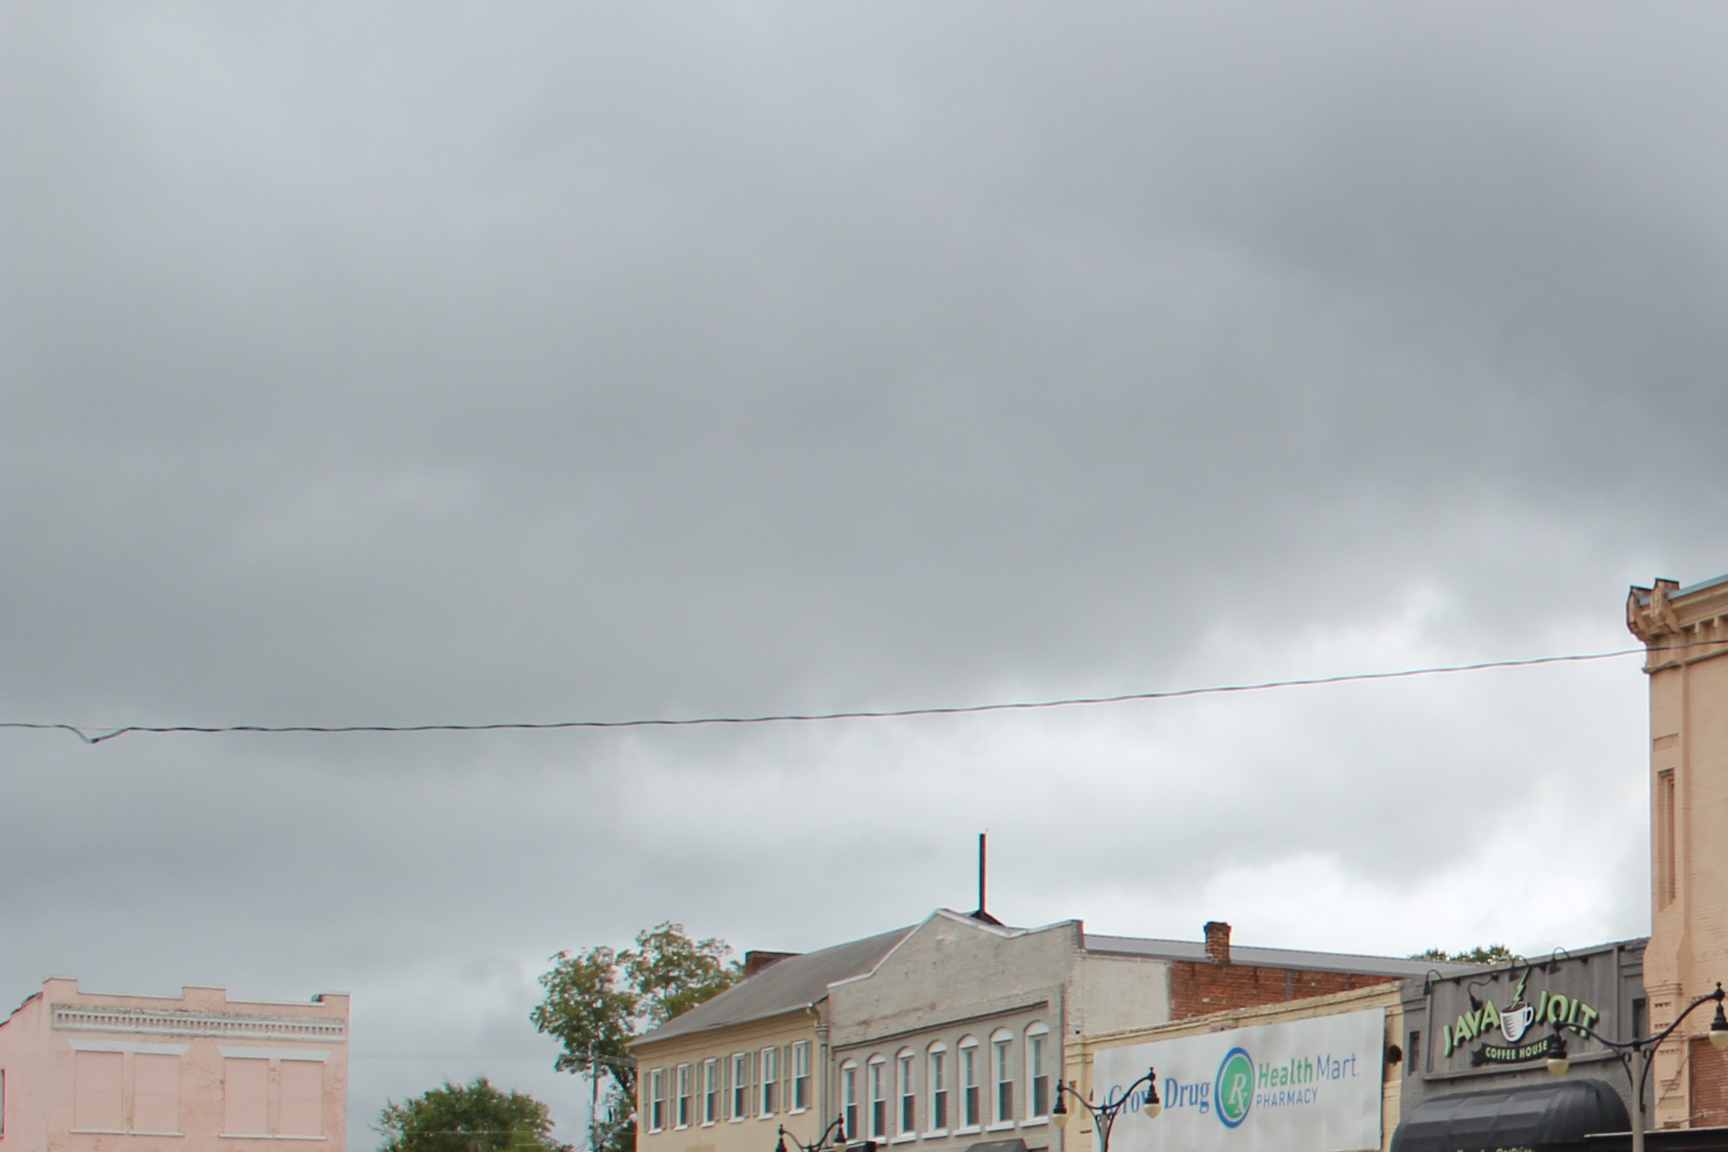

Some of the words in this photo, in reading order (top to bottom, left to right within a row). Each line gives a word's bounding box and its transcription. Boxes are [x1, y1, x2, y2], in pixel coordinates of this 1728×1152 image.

[1443, 1000, 1501, 1057] JAVA
[1535, 990, 1599, 1038] JOLT
[1485, 1046, 1516, 1060] COFFEE
[1519, 1040, 1548, 1059] HOUSE
[1257, 1056, 1313, 1089] Health
[1316, 1052, 1357, 1081] Mart
[1163, 1077, 1210, 1114] Drug
[1256, 1087, 1318, 1109] PHARMACY
